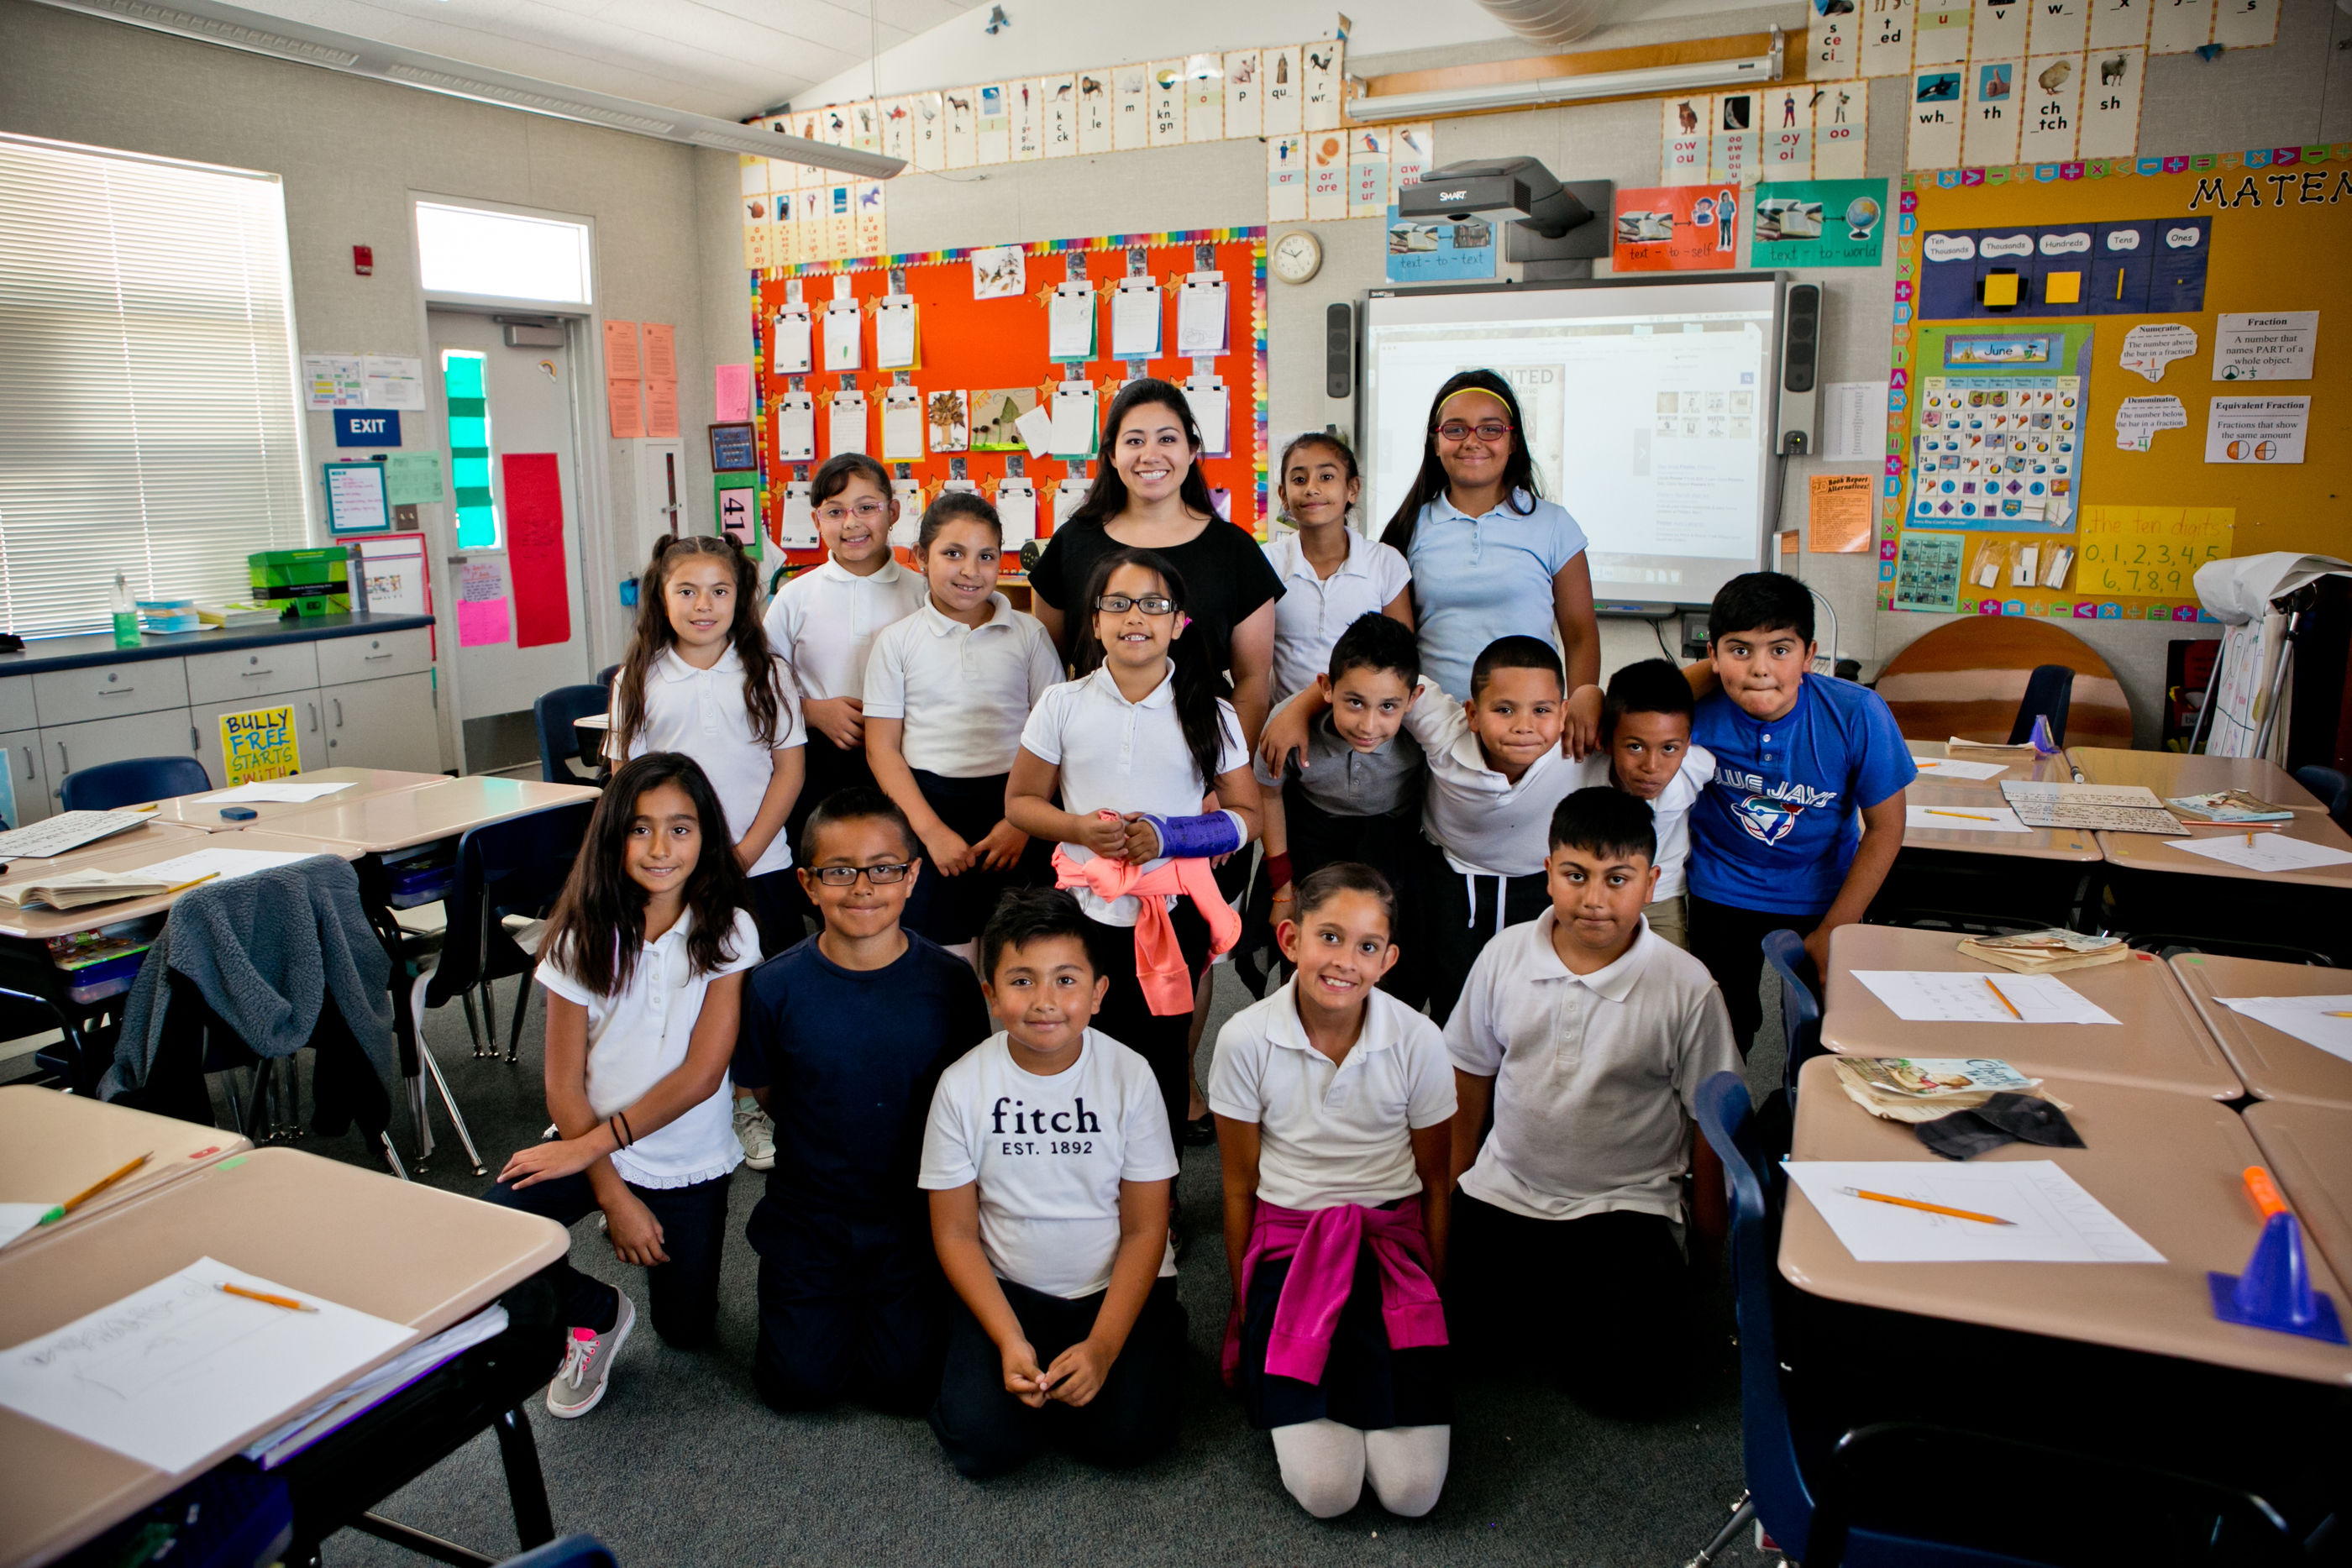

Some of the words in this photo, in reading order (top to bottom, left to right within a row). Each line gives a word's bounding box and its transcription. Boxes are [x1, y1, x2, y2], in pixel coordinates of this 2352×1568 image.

[1939, 14, 1948, 24] u
[1996, 10, 2005, 20] v
[1830, 24, 1836, 33] s
[1884, 18, 1892, 29] t
[1239, 91, 1247, 102] p
[1125, 103, 1135, 113] m
[2100, 96, 2120, 110] sh
[1983, 106, 2001, 119] th
[2040, 102, 2061, 116] ch
[1830, 128, 1850, 139] oo
[1674, 140, 1696, 151] ow
[1677, 153, 1693, 164] ou
[1780, 148, 1794, 160] oi
[1363, 166, 1373, 177] ir
[1401, 165, 1420, 174] aw
[1279, 172, 1293, 182] ar
[1320, 171, 1334, 181] or
[1316, 182, 1338, 192] ore
[1362, 179, 1375, 189] er
[1362, 191, 1375, 201] ur
[1440, 190, 1467, 202] SMART
[1930, 238, 1945, 246] Ten
[2114, 236, 2133, 244] Tens
[2171, 233, 2193, 243] Ones
[1987, 242, 2025, 251] Thousands
[2045, 239, 2083, 249] Hundreds
[1630, 246, 1647, 260] text
[1669, 247, 1681, 256] to
[1770, 246, 1798, 261] text
[1819, 245, 1833, 259] to
[1930, 245, 1969, 255] Thousands
[1400, 256, 1422, 269] text
[1436, 254, 1448, 265] to
[1462, 252, 1483, 265] text
[2248, 317, 2287, 327] Fraction
[2142, 339, 2170, 348] number
[1984, 344, 2013, 356] June
[2234, 357, 2261, 365] whole
[2263, 357, 2292, 366] object.
[2216, 401, 2264, 410] Equivalent
[2266, 401, 2305, 410] Fraction
[350, 418, 386, 433] EXIT
[1828, 476, 1845, 485] Book
[1846, 476, 1868, 485] Report
[1828, 483, 1869, 493] Alternatives!
[724, 497, 746, 531] 41
[2092, 509, 2122, 534] the
[2134, 510, 2161, 533] ten
[225, 709, 287, 733] BULLY
[229, 726, 291, 755] FREE
[232, 747, 292, 772] STARTS
[1767, 780, 1838, 808] JAYS
[991, 1096, 1102, 1135] fitch
[1002, 1142, 1041, 1156] EST.
[1051, 1141, 1093, 1154] 1892
